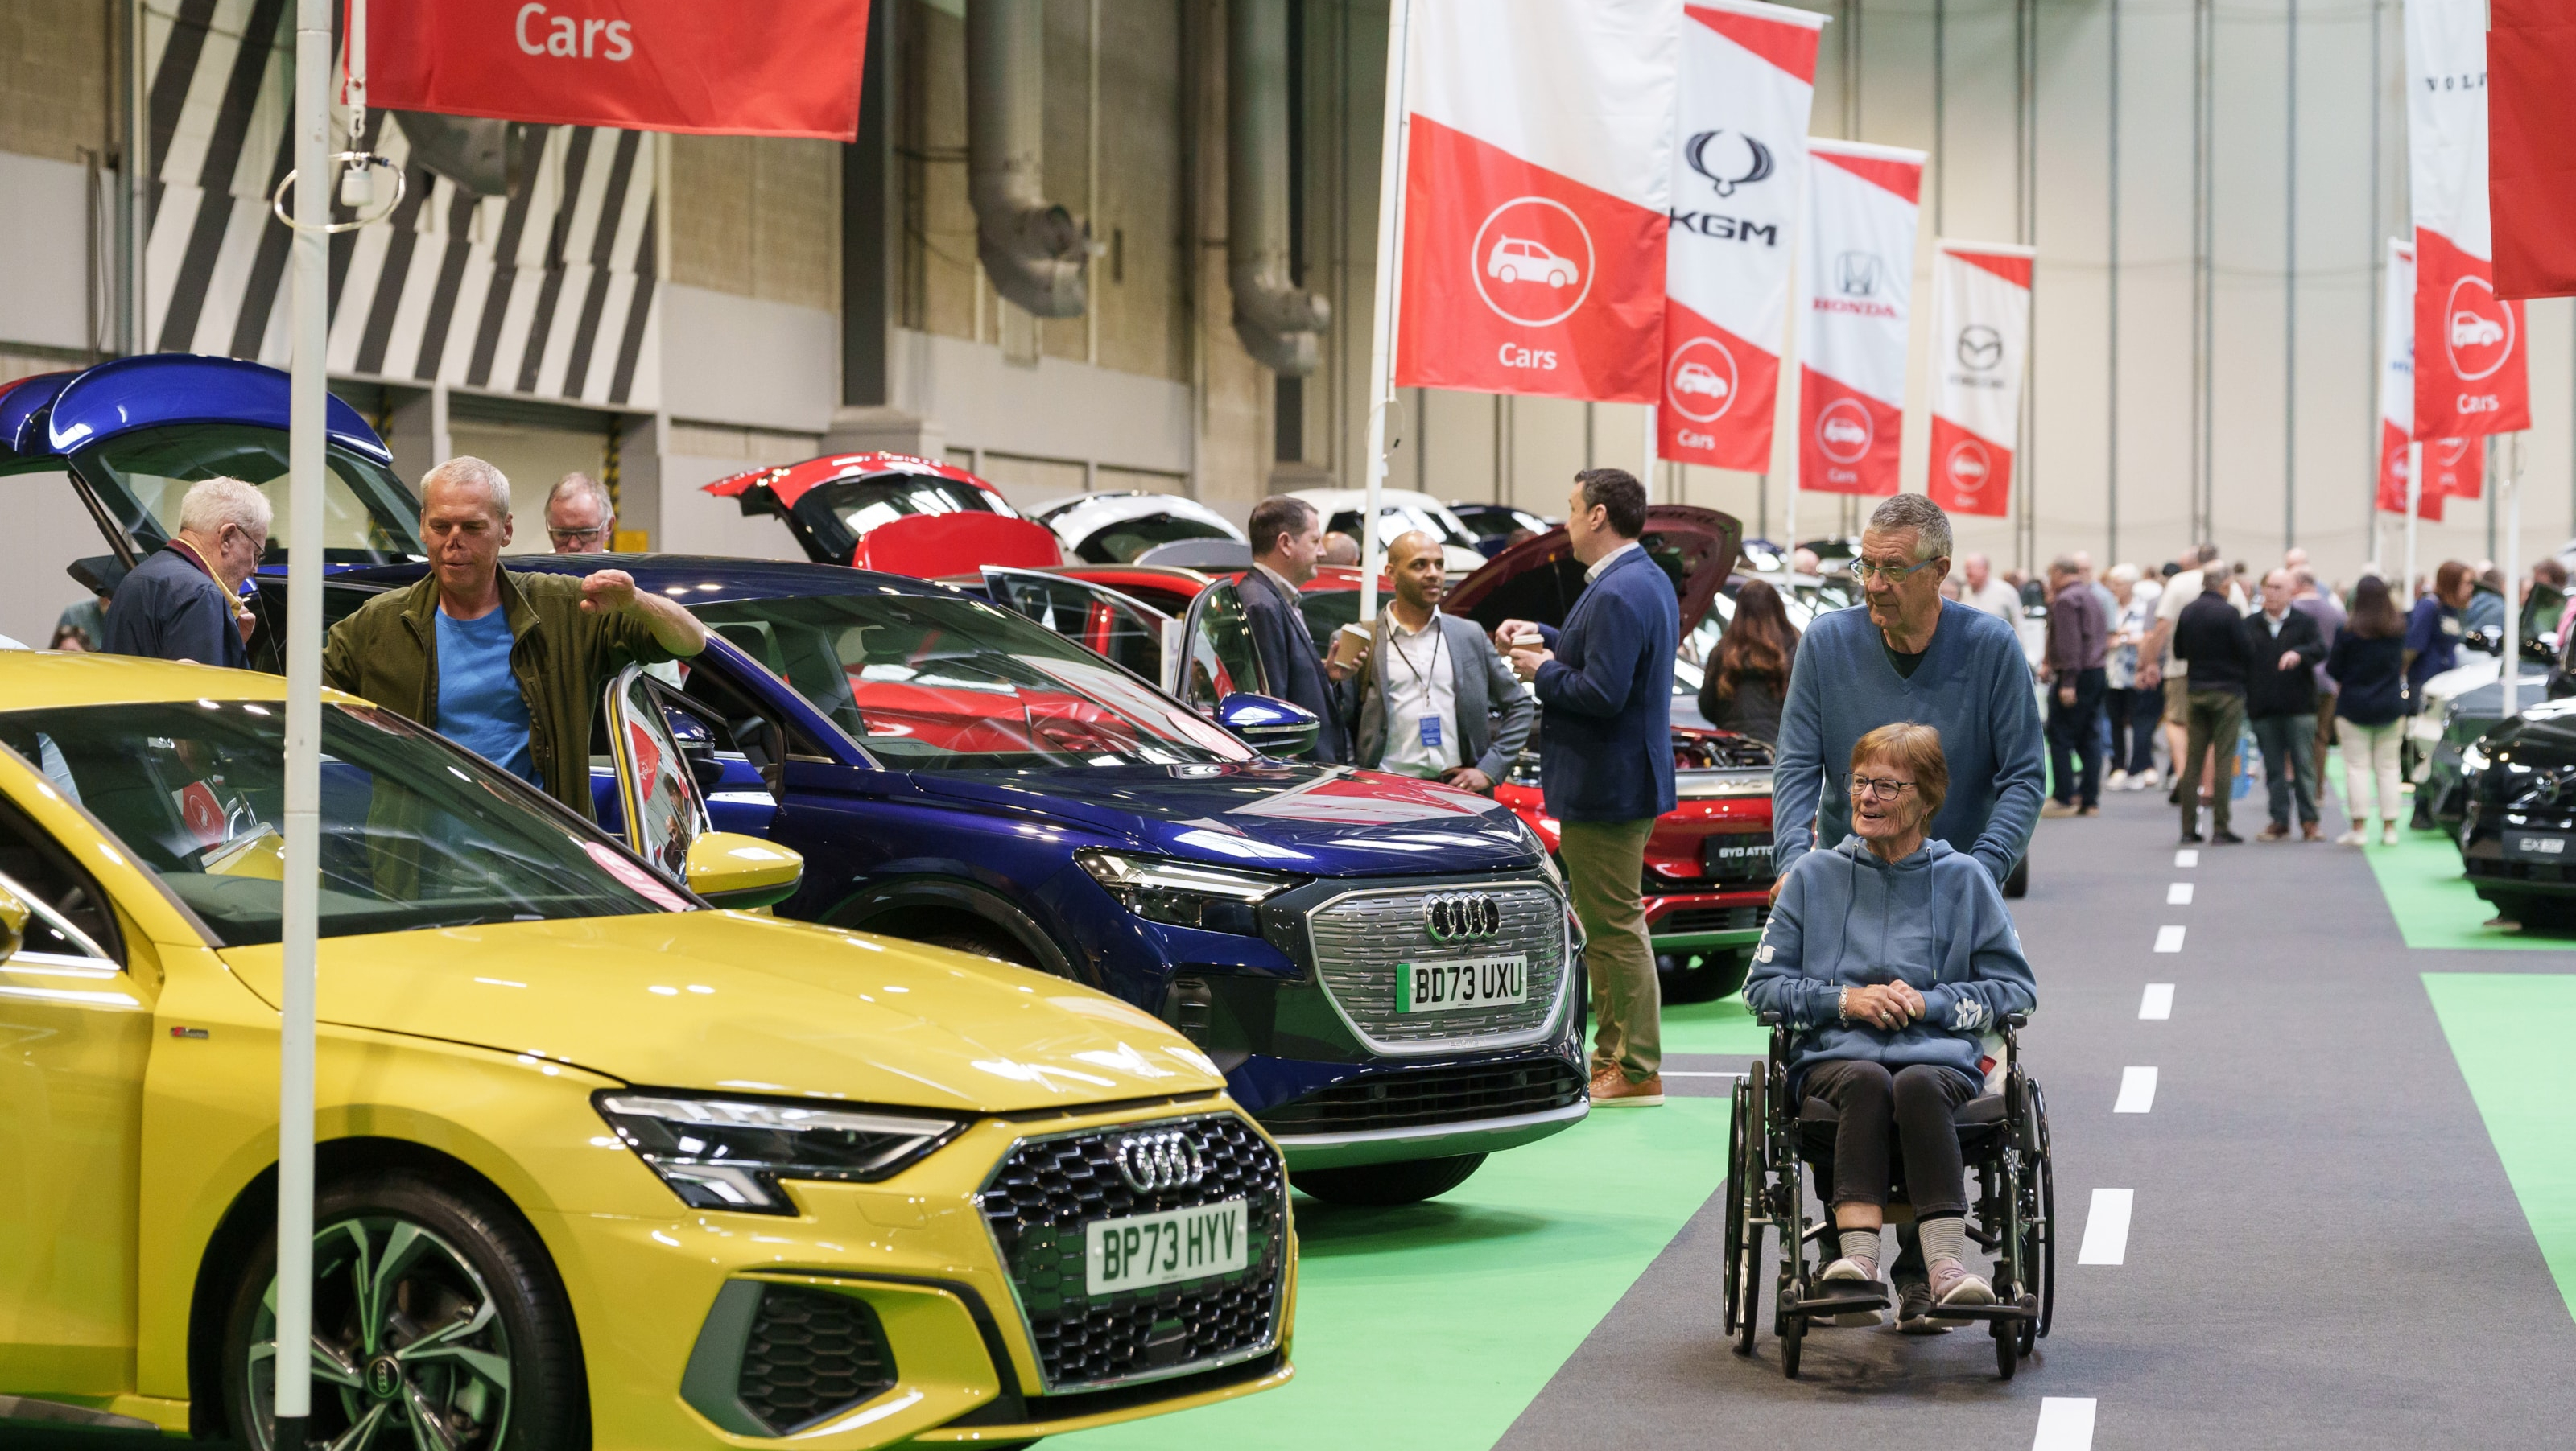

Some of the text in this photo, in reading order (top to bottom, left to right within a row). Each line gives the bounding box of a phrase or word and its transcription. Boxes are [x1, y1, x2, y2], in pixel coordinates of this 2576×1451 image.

[515, 2, 634, 61] Cars
[2425, 72, 2487, 91] VOLV
[1669, 206, 1777, 246] KGM
[1498, 342, 1558, 370] Cars
[2456, 393, 2500, 414] Cars
[1677, 427, 1715, 451] Cars
[1719, 847, 1745, 859] BYD
[1415, 962, 1523, 1004] BD73 UXU
[1103, 1210, 1236, 1281] BP73 HYV
